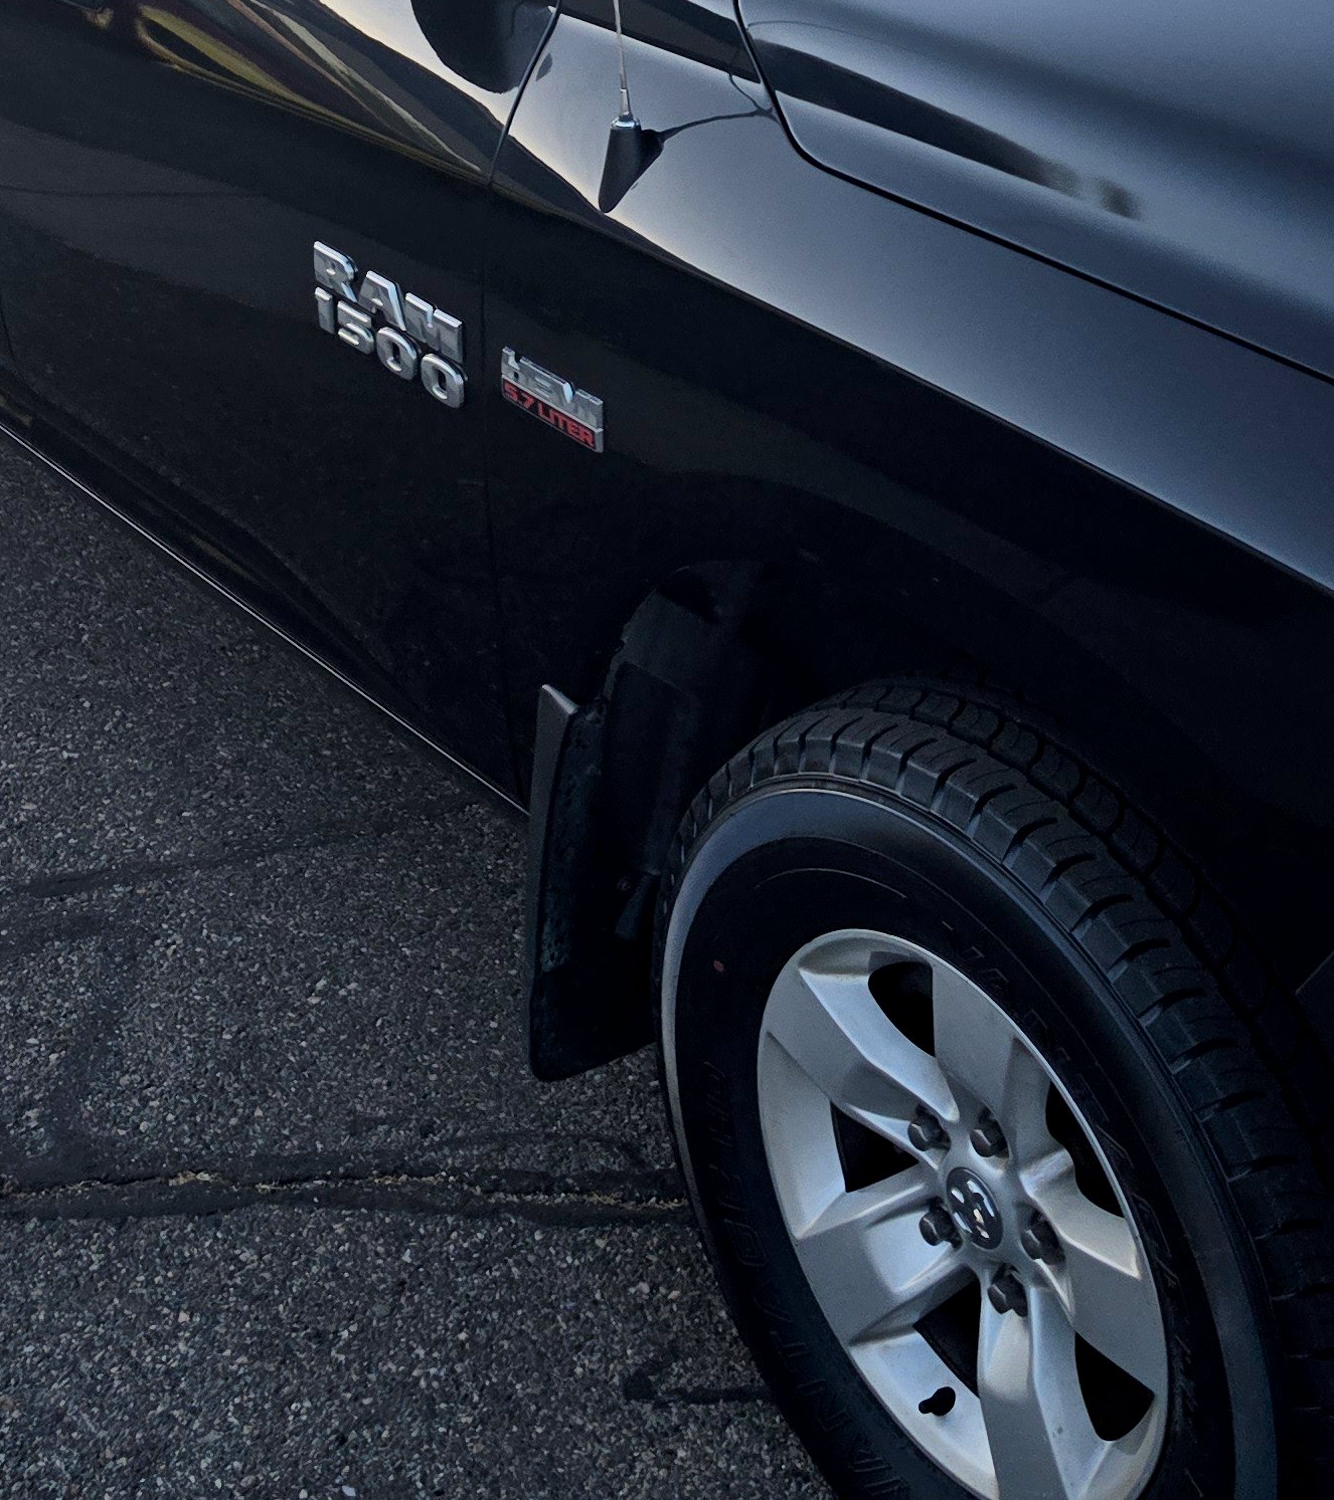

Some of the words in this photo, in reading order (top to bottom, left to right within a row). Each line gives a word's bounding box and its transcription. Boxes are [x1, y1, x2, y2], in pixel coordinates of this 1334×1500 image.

[314, 240, 464, 364] RAM
[315, 286, 468, 409] 1500
[537, 402, 596, 448] LITER
